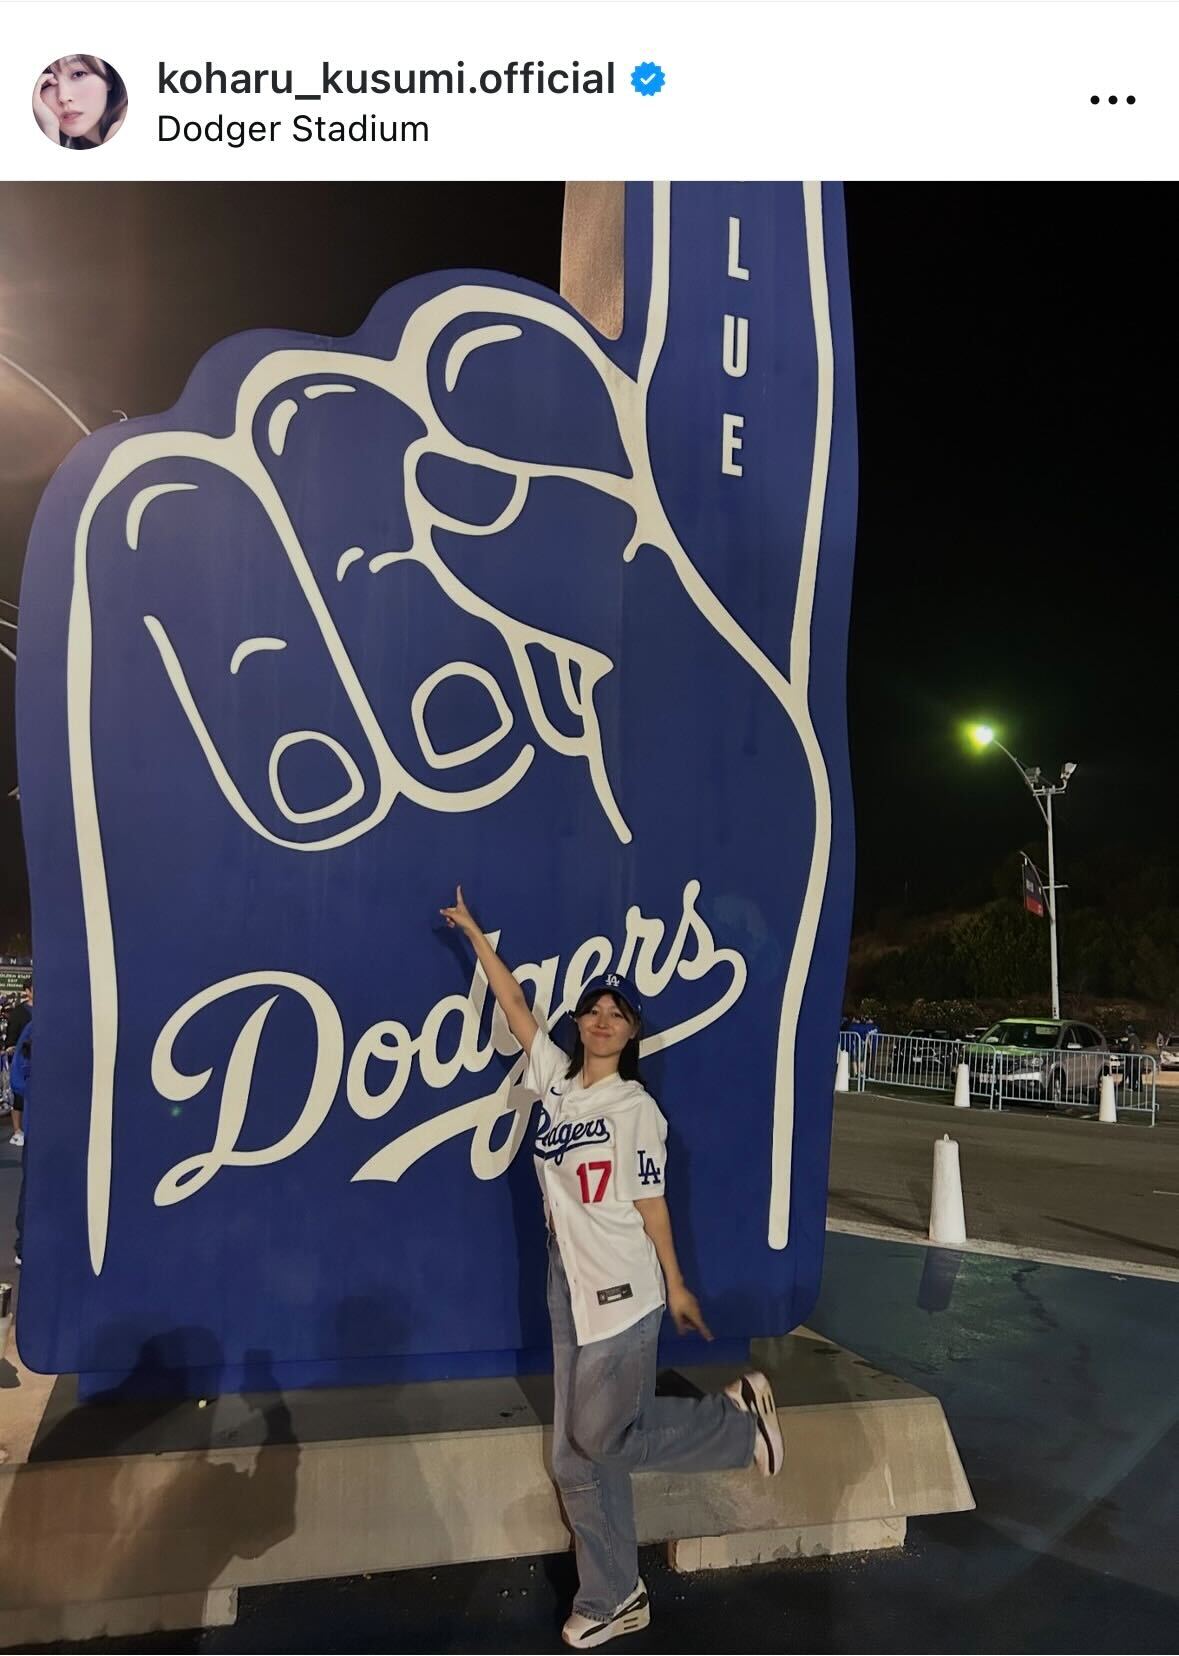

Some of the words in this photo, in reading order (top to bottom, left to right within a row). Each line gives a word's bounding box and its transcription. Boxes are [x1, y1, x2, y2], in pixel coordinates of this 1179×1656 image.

[605, 973, 621, 987] LA
[576, 1160, 612, 1204] 17
[636, 1149, 661, 1186] LA
